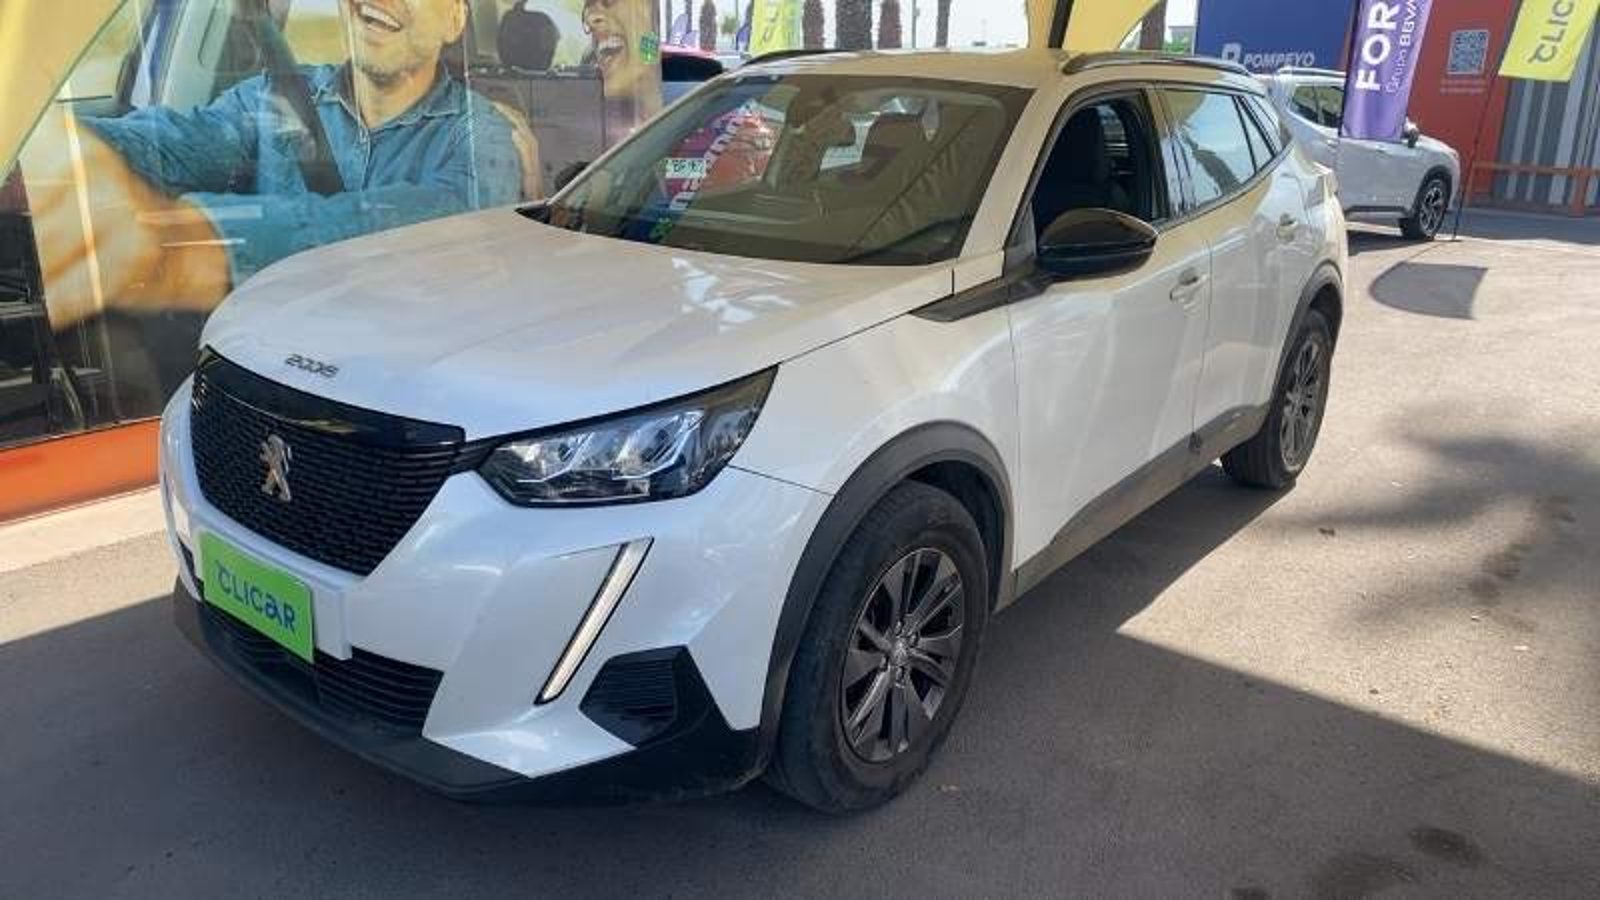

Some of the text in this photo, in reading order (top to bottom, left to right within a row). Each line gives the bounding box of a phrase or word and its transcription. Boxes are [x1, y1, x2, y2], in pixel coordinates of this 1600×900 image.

[1355, 1, 1401, 91] FOR
[1243, 51, 1315, 68] POMPEYO
[286, 354, 338, 378] 2008
